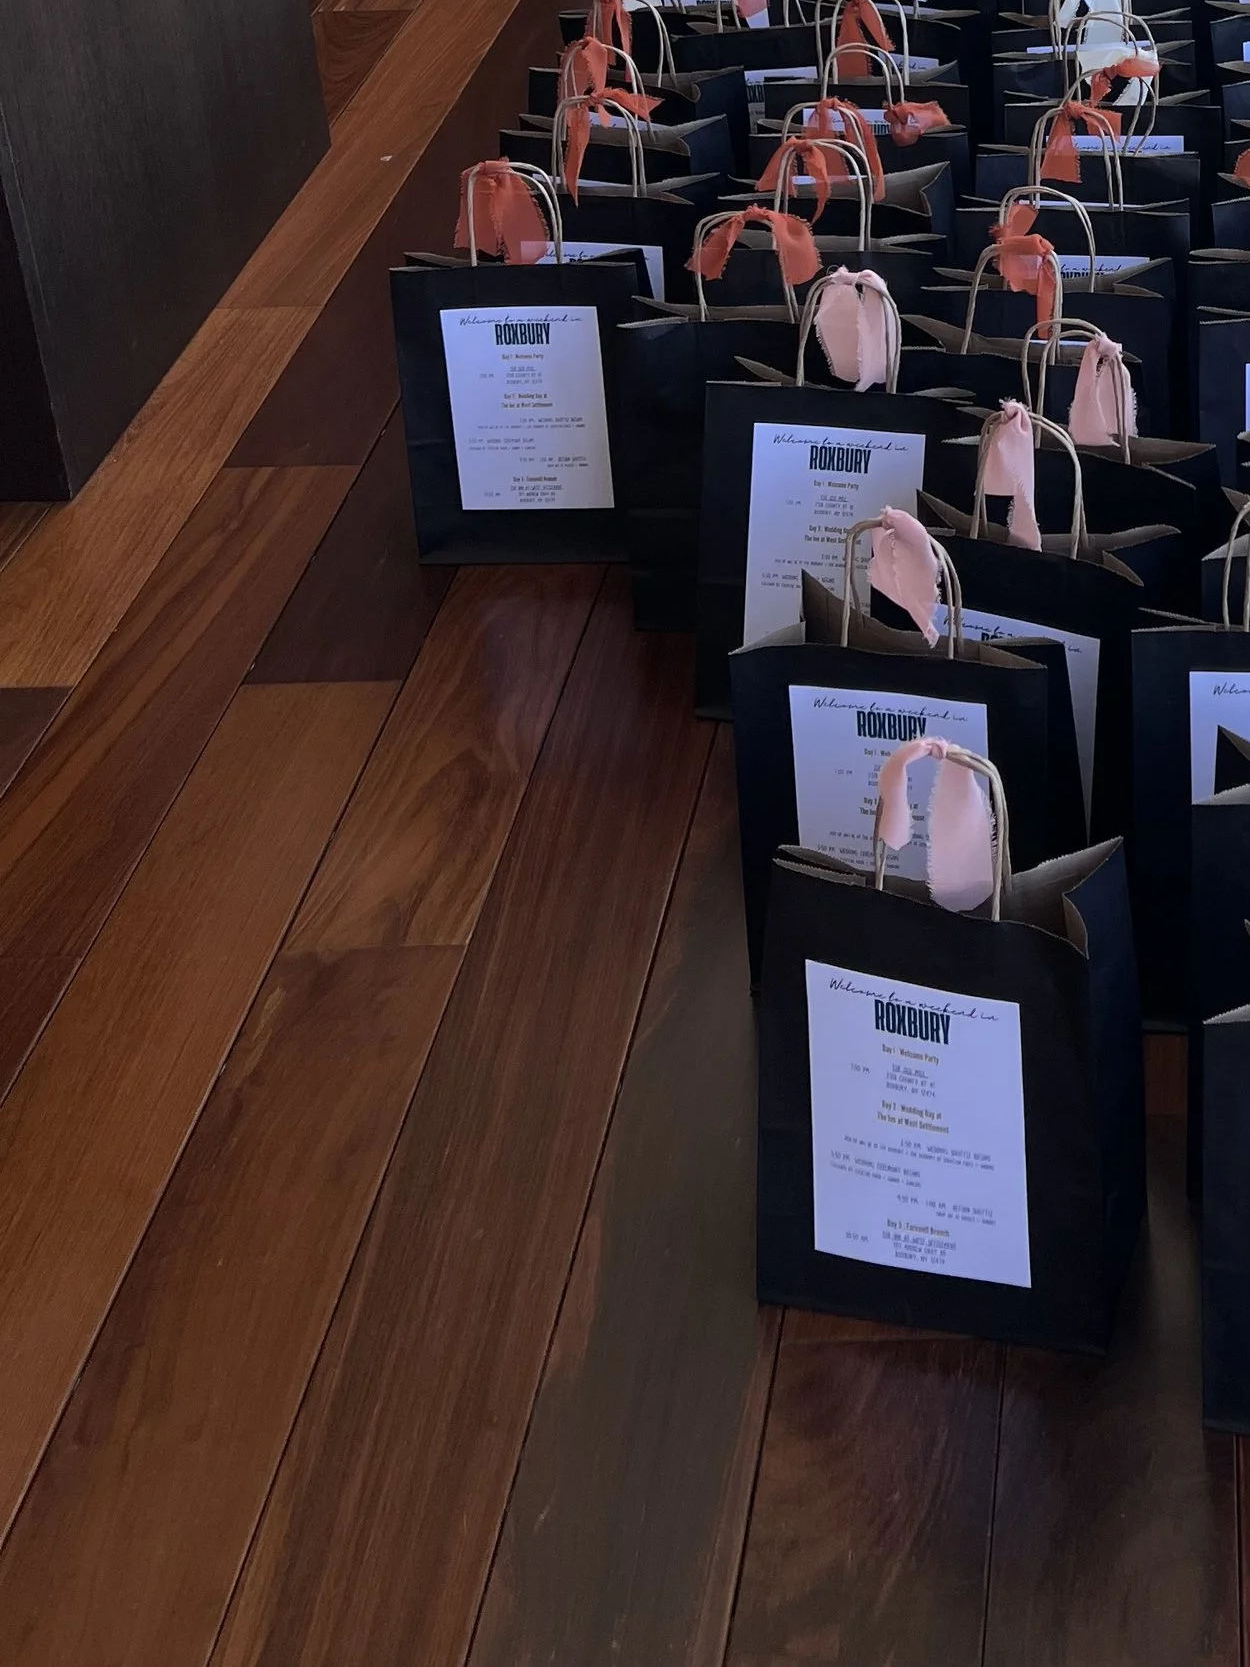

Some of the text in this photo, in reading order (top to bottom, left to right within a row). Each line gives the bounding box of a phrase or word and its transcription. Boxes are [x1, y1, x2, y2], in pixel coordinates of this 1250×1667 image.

[460, 317, 501, 326] Welcome
[504, 315, 515, 325] to
[526, 313, 568, 323] weekend
[495, 322, 550, 346] ROXBURY
[773, 433, 820, 444] Welcome
[823, 436, 834, 445] to
[847, 439, 892, 451] weekend
[809, 445, 871, 474] ROXBURY
[814, 696, 868, 710] Welcome
[869, 702, 883, 712] to
[898, 707, 950, 720] weekend
[857, 711, 927, 741] ROXBURY
[829, 978, 886, 1000] Welcome
[888, 991, 902, 1003] to
[918, 1001, 978, 1019] weekend
[980, 1013, 999, 1022] in
[874, 999, 950, 1045] ROXBURY
[882, 1044, 893, 1055] Day
[925, 1054, 940, 1065] Party
[882, 1100, 892, 1111] Day
[925, 1110, 934, 1120] Day
[887, 1218, 897, 1229] Day
